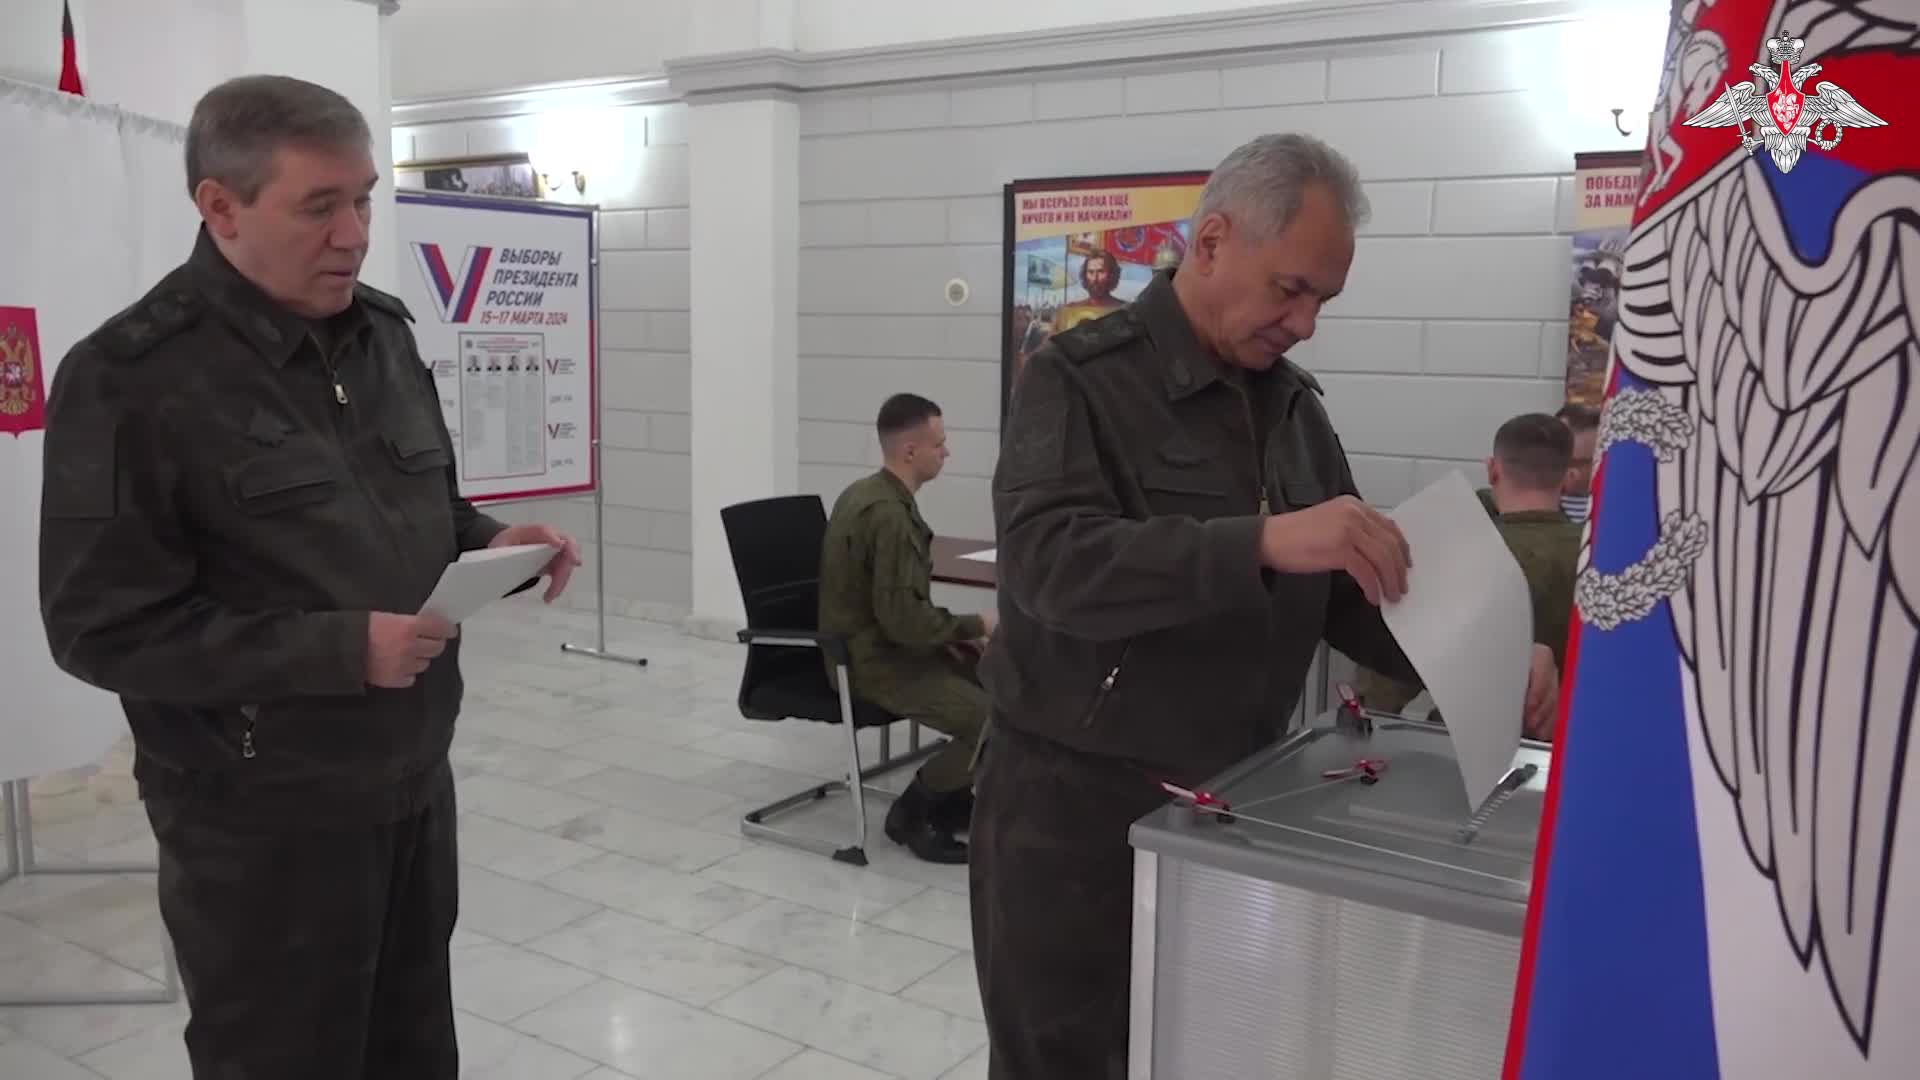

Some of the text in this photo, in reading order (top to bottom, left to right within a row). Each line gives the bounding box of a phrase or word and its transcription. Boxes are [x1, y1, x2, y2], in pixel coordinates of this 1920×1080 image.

[1023, 199, 1038, 209] МЫ
[1082, 195, 1106, 206] ПОКА
[1585, 194, 1601, 208] ЗА
[1023, 212, 1054, 224] НИЧЕГО
[1055, 213, 1061, 222] И
[1063, 212, 1074, 222] НЕ
[500, 248, 562, 266] ВЫБОРЫ
[493, 269, 579, 288] ПРЕЗИДЕНТА
[486, 290, 544, 306] РОССИИ
[511, 311, 545, 326] МАРТА
[545, 312, 568, 326] 2024
